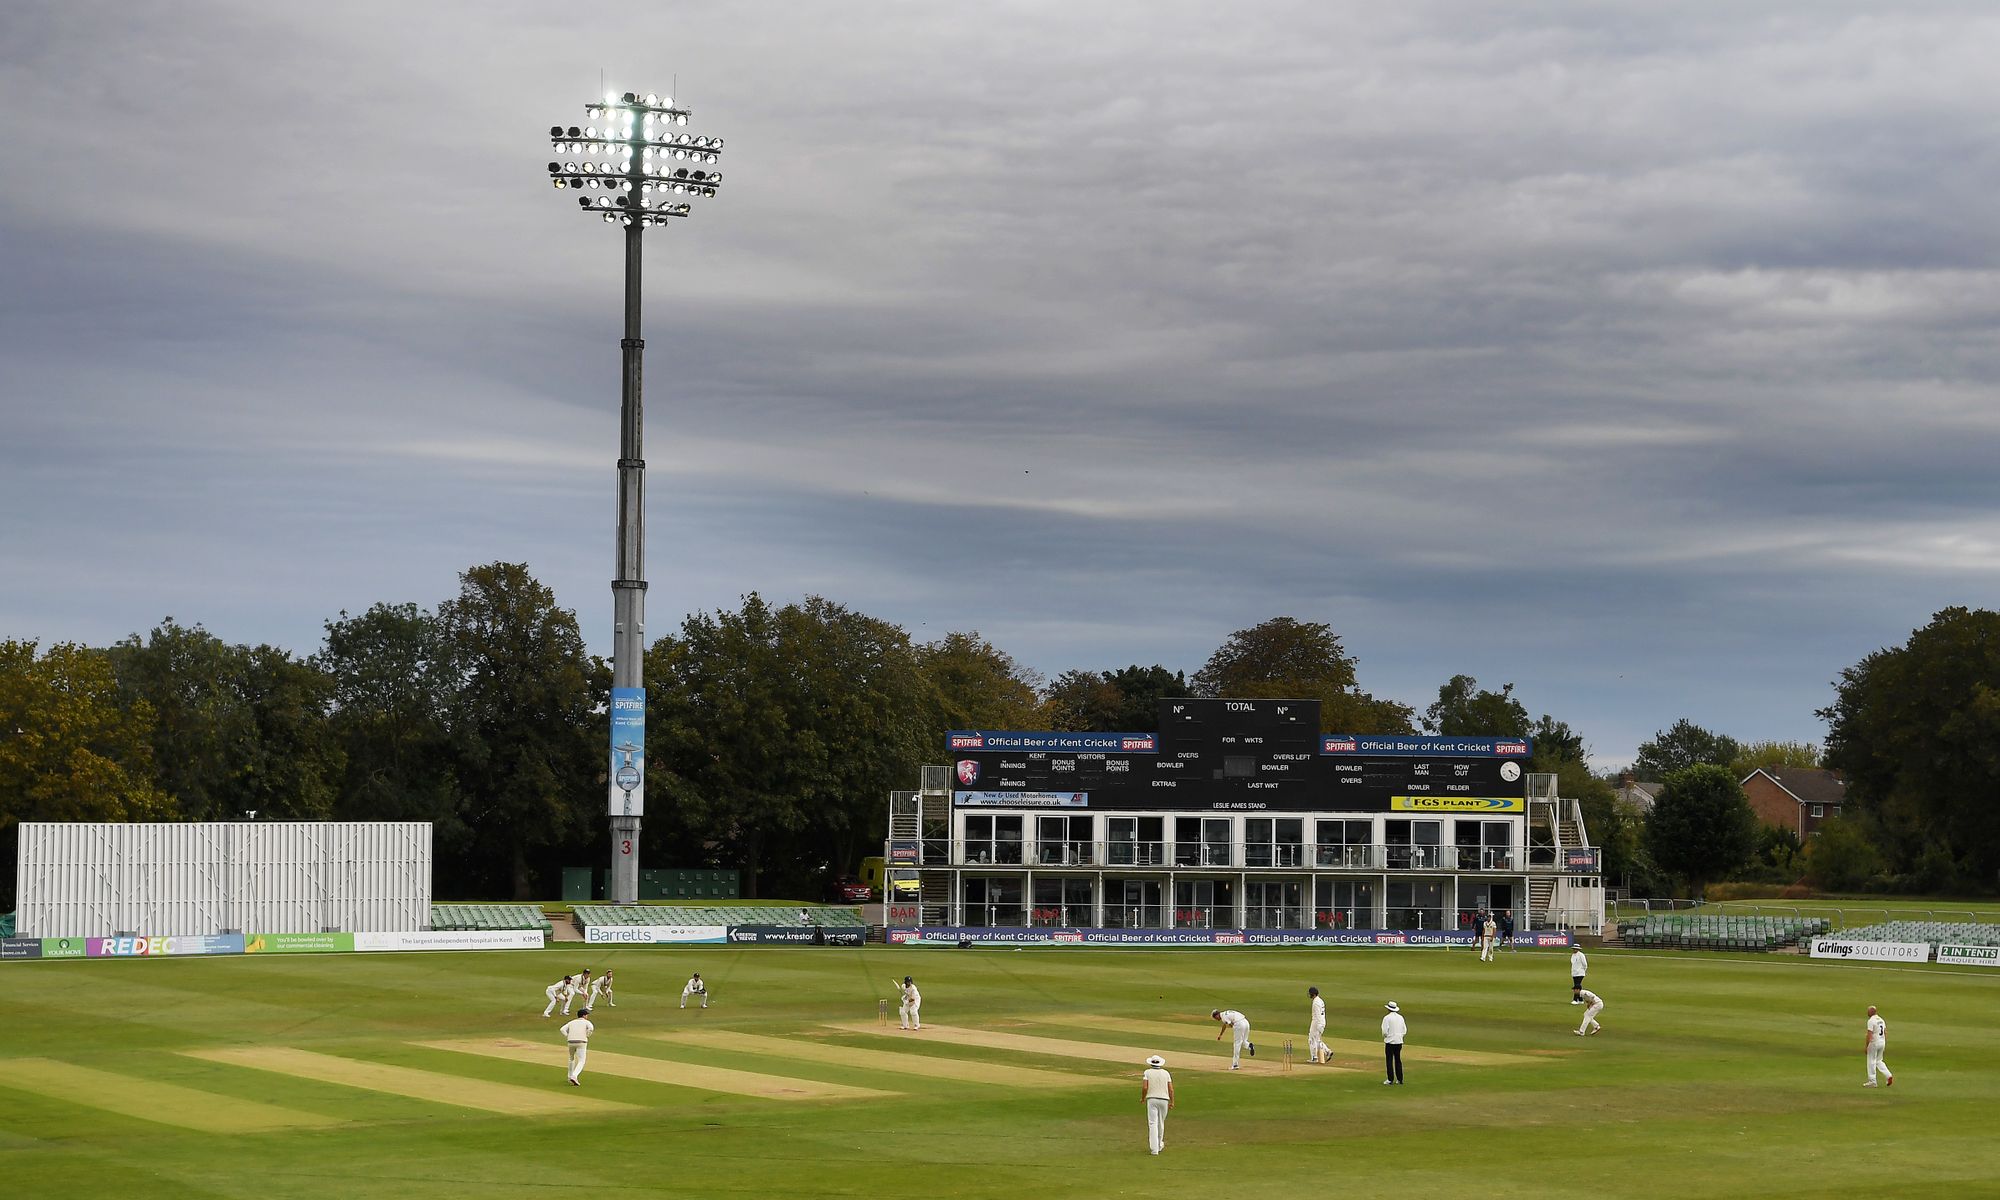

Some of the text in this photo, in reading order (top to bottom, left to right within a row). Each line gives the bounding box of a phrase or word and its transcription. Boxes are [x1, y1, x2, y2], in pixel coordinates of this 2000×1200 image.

[615, 702, 643, 710] SPITFIRE
[1226, 702, 1256, 711] TOTAL
[952, 738, 982, 747] SPITFIRE
[988, 738, 1117, 748] Official Beer of Kent Cricket
[1123, 740, 1152, 749] SPITFIRE
[1326, 742, 1356, 751] SPITFIRE
[1362, 742, 1490, 752] Official Beer of Kent Cricket
[1496, 745, 1526, 754] SPITFIRE
[1414, 798, 1440, 806] FGS
[622, 840, 631, 854] 3
[891, 908, 916, 918] BAR
[1318, 912, 1343, 922] BAR
[1461, 912, 1476, 924] BA
[590, 928, 652, 941] Barretts
[1144, 934, 1154, 942] of
[101, 938, 176, 955] REDEC
[1818, 942, 1918, 957] Girlings SOLICITORS
[1965, 948, 1996, 958] TENTS
[1879, 1025, 1884, 1036] 3
